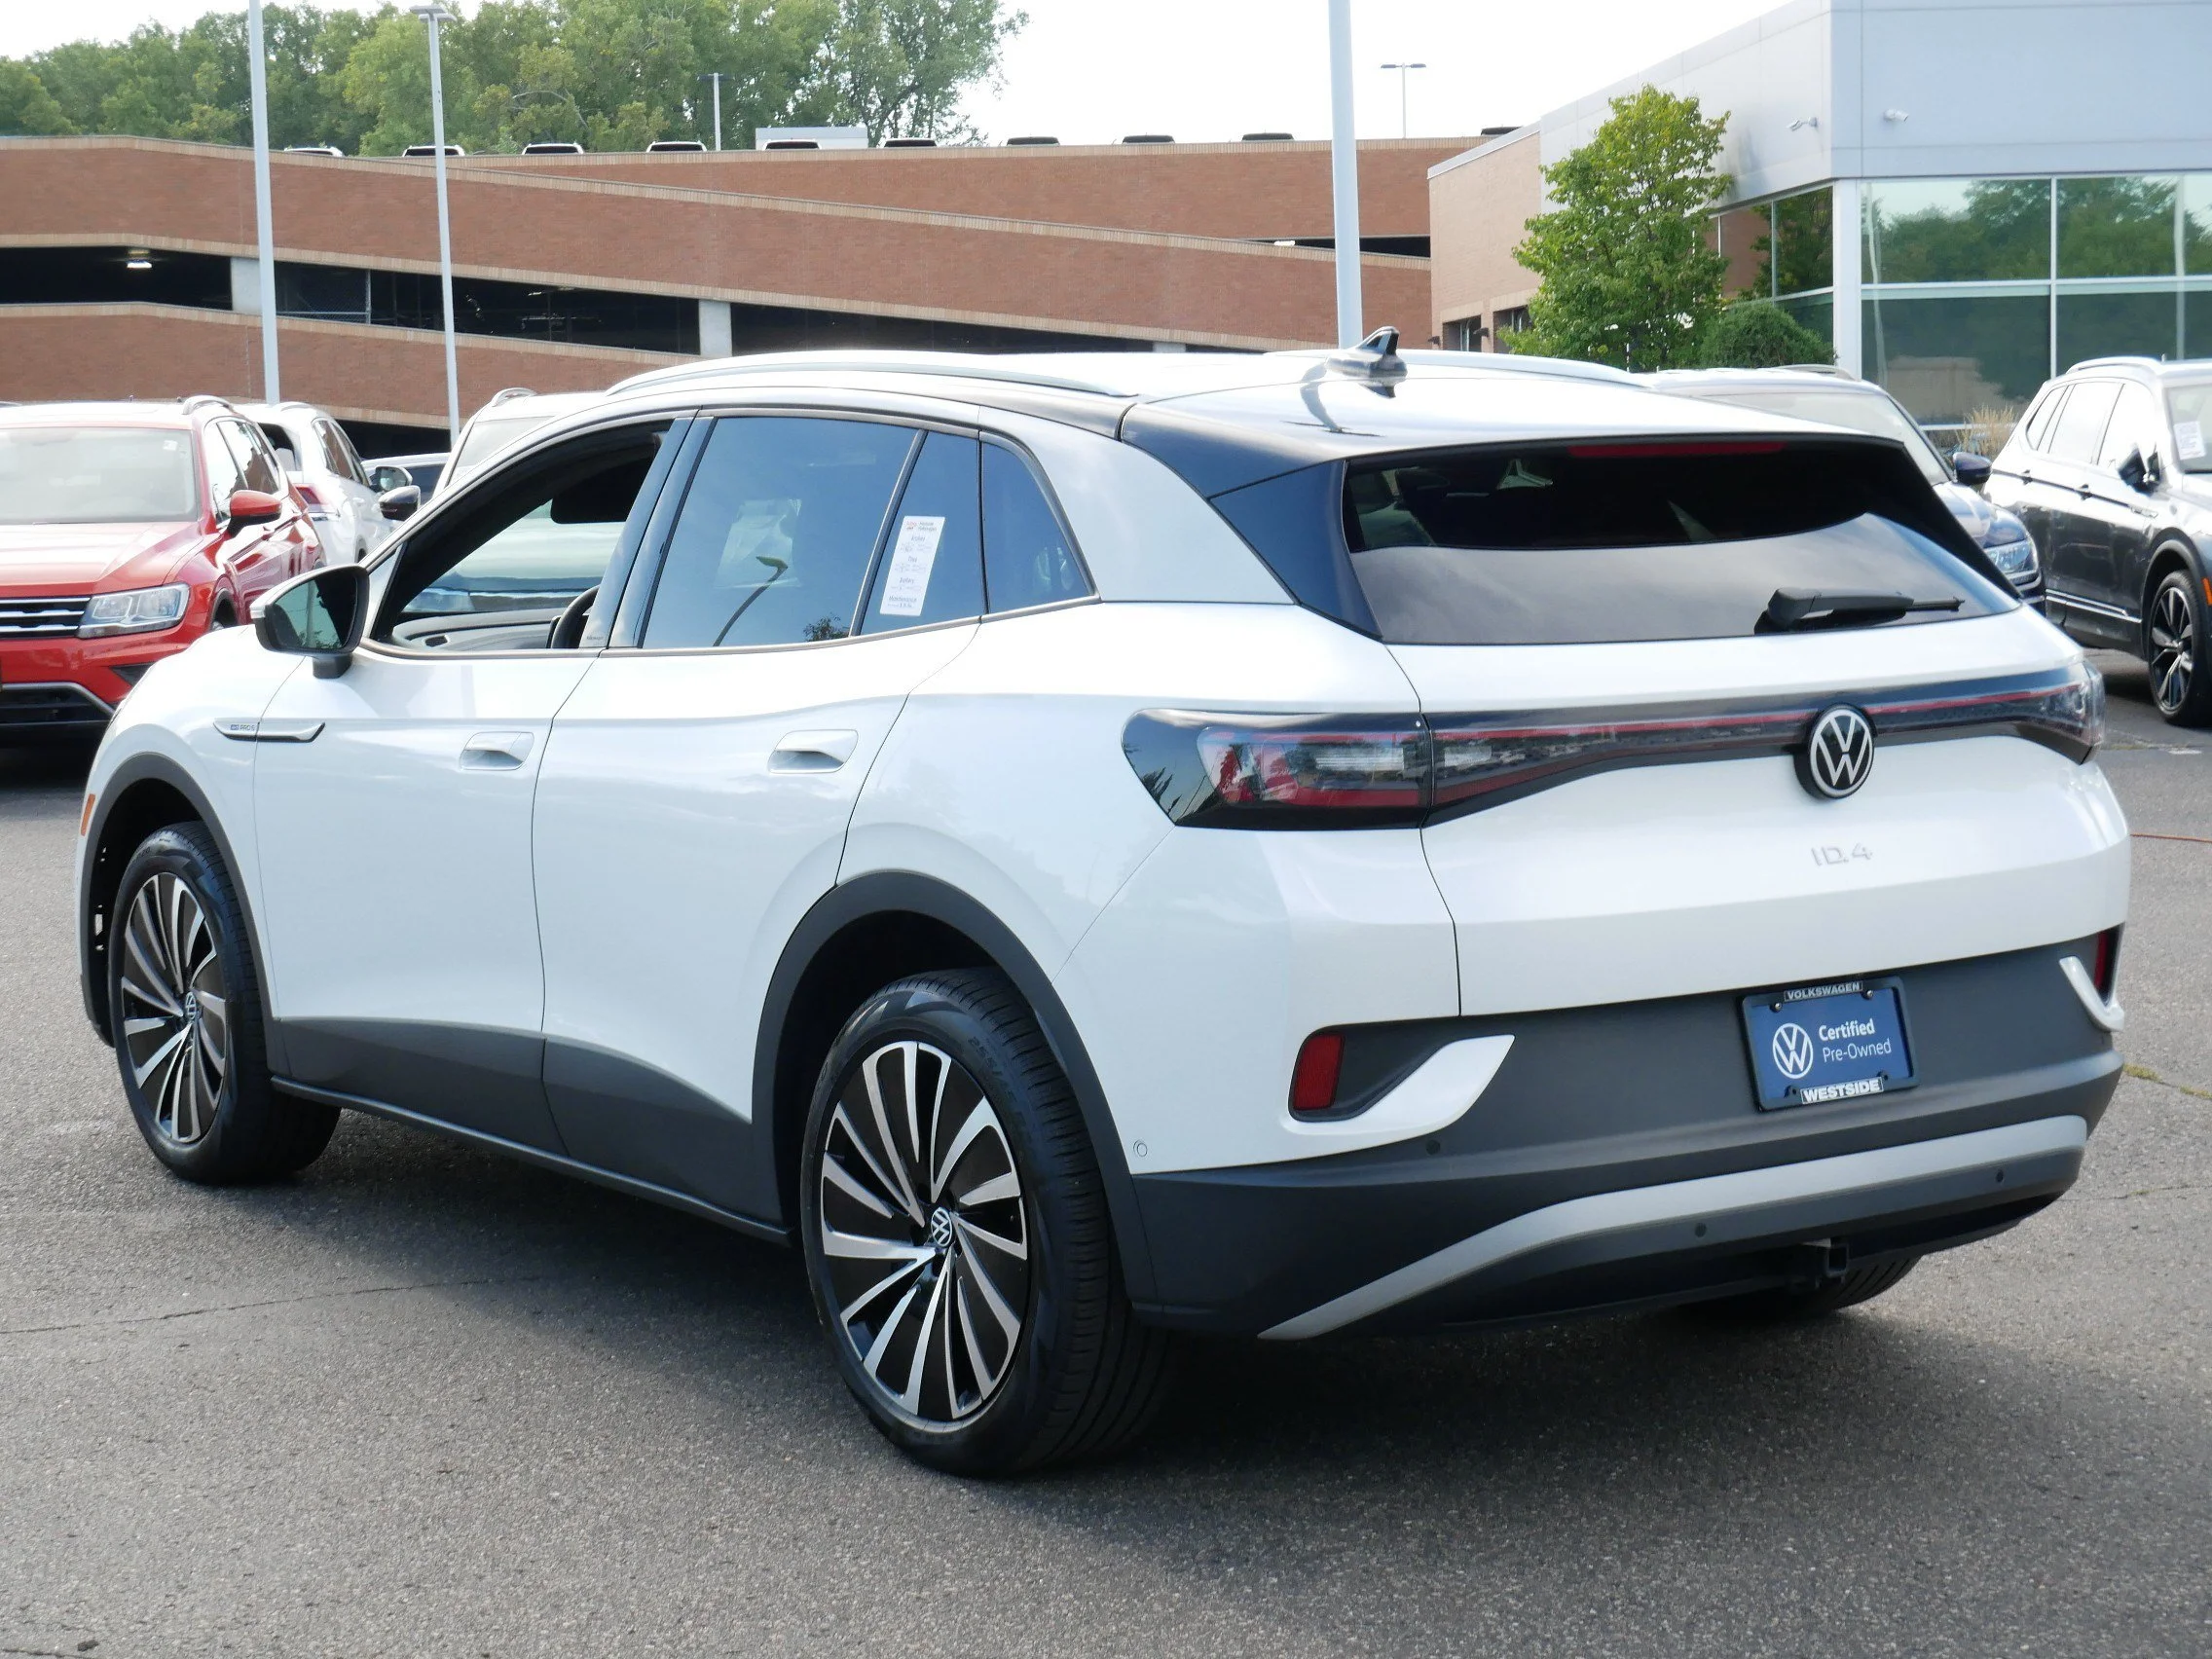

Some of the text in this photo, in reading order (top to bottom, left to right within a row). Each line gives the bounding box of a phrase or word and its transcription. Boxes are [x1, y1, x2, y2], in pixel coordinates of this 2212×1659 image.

[1788, 982, 1861, 1001] VOLKSWAGEN
[1818, 1018, 1875, 1042] Certified
[1773, 1022, 1814, 1080] VW
[1822, 1038, 1893, 1063] Pre-Owned
[1803, 1079, 1881, 1102] WESTSIDE
